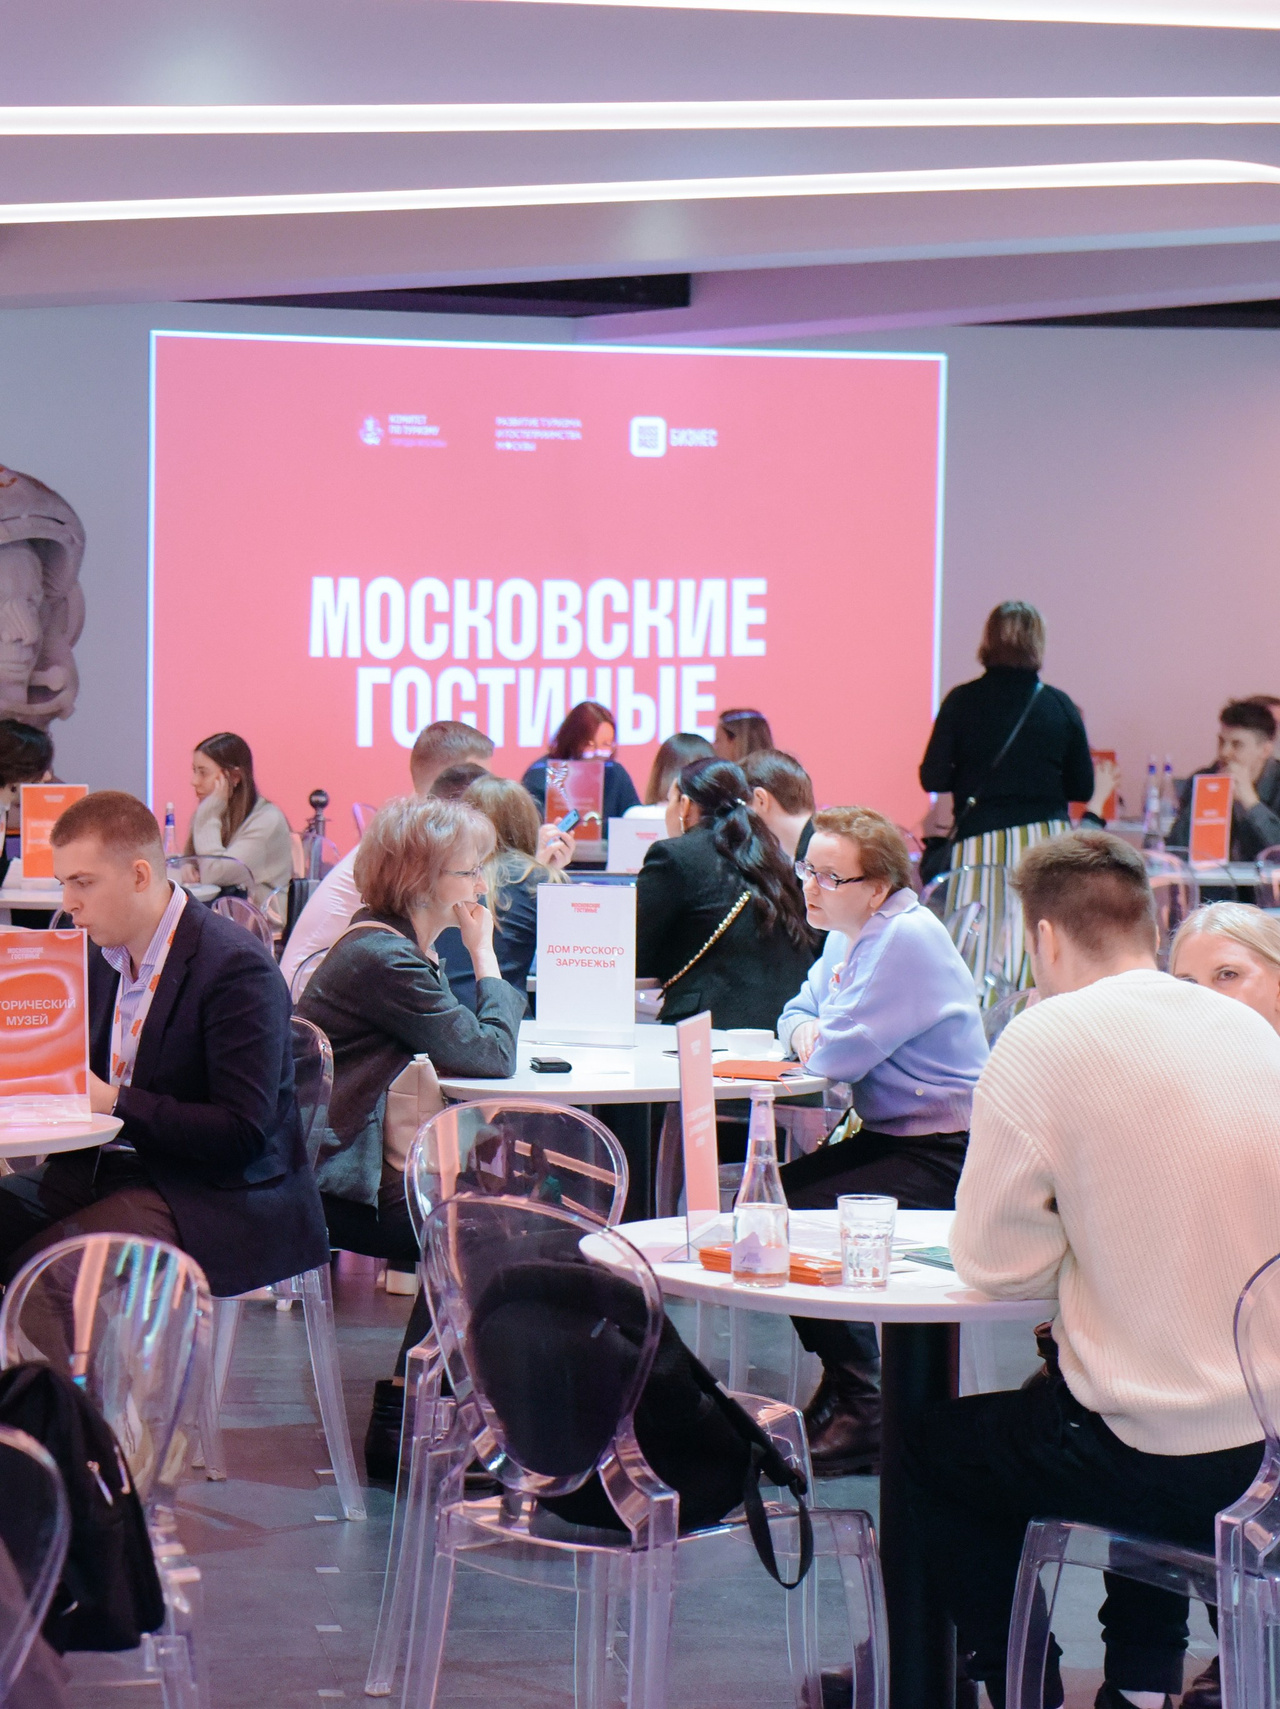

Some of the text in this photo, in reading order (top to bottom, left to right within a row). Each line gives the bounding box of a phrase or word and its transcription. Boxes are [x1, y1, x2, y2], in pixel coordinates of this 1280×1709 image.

[669, 428, 718, 447] БИЗНЕС
[308, 576, 768, 661] МОСКОВСКИЕ
[546, 944, 625, 956] ДОМ РУССКОГО
[556, 958, 616, 968] ЗАРУБЕЖЬЯ
[6, 1013, 49, 1026] МУЗЕЙ
